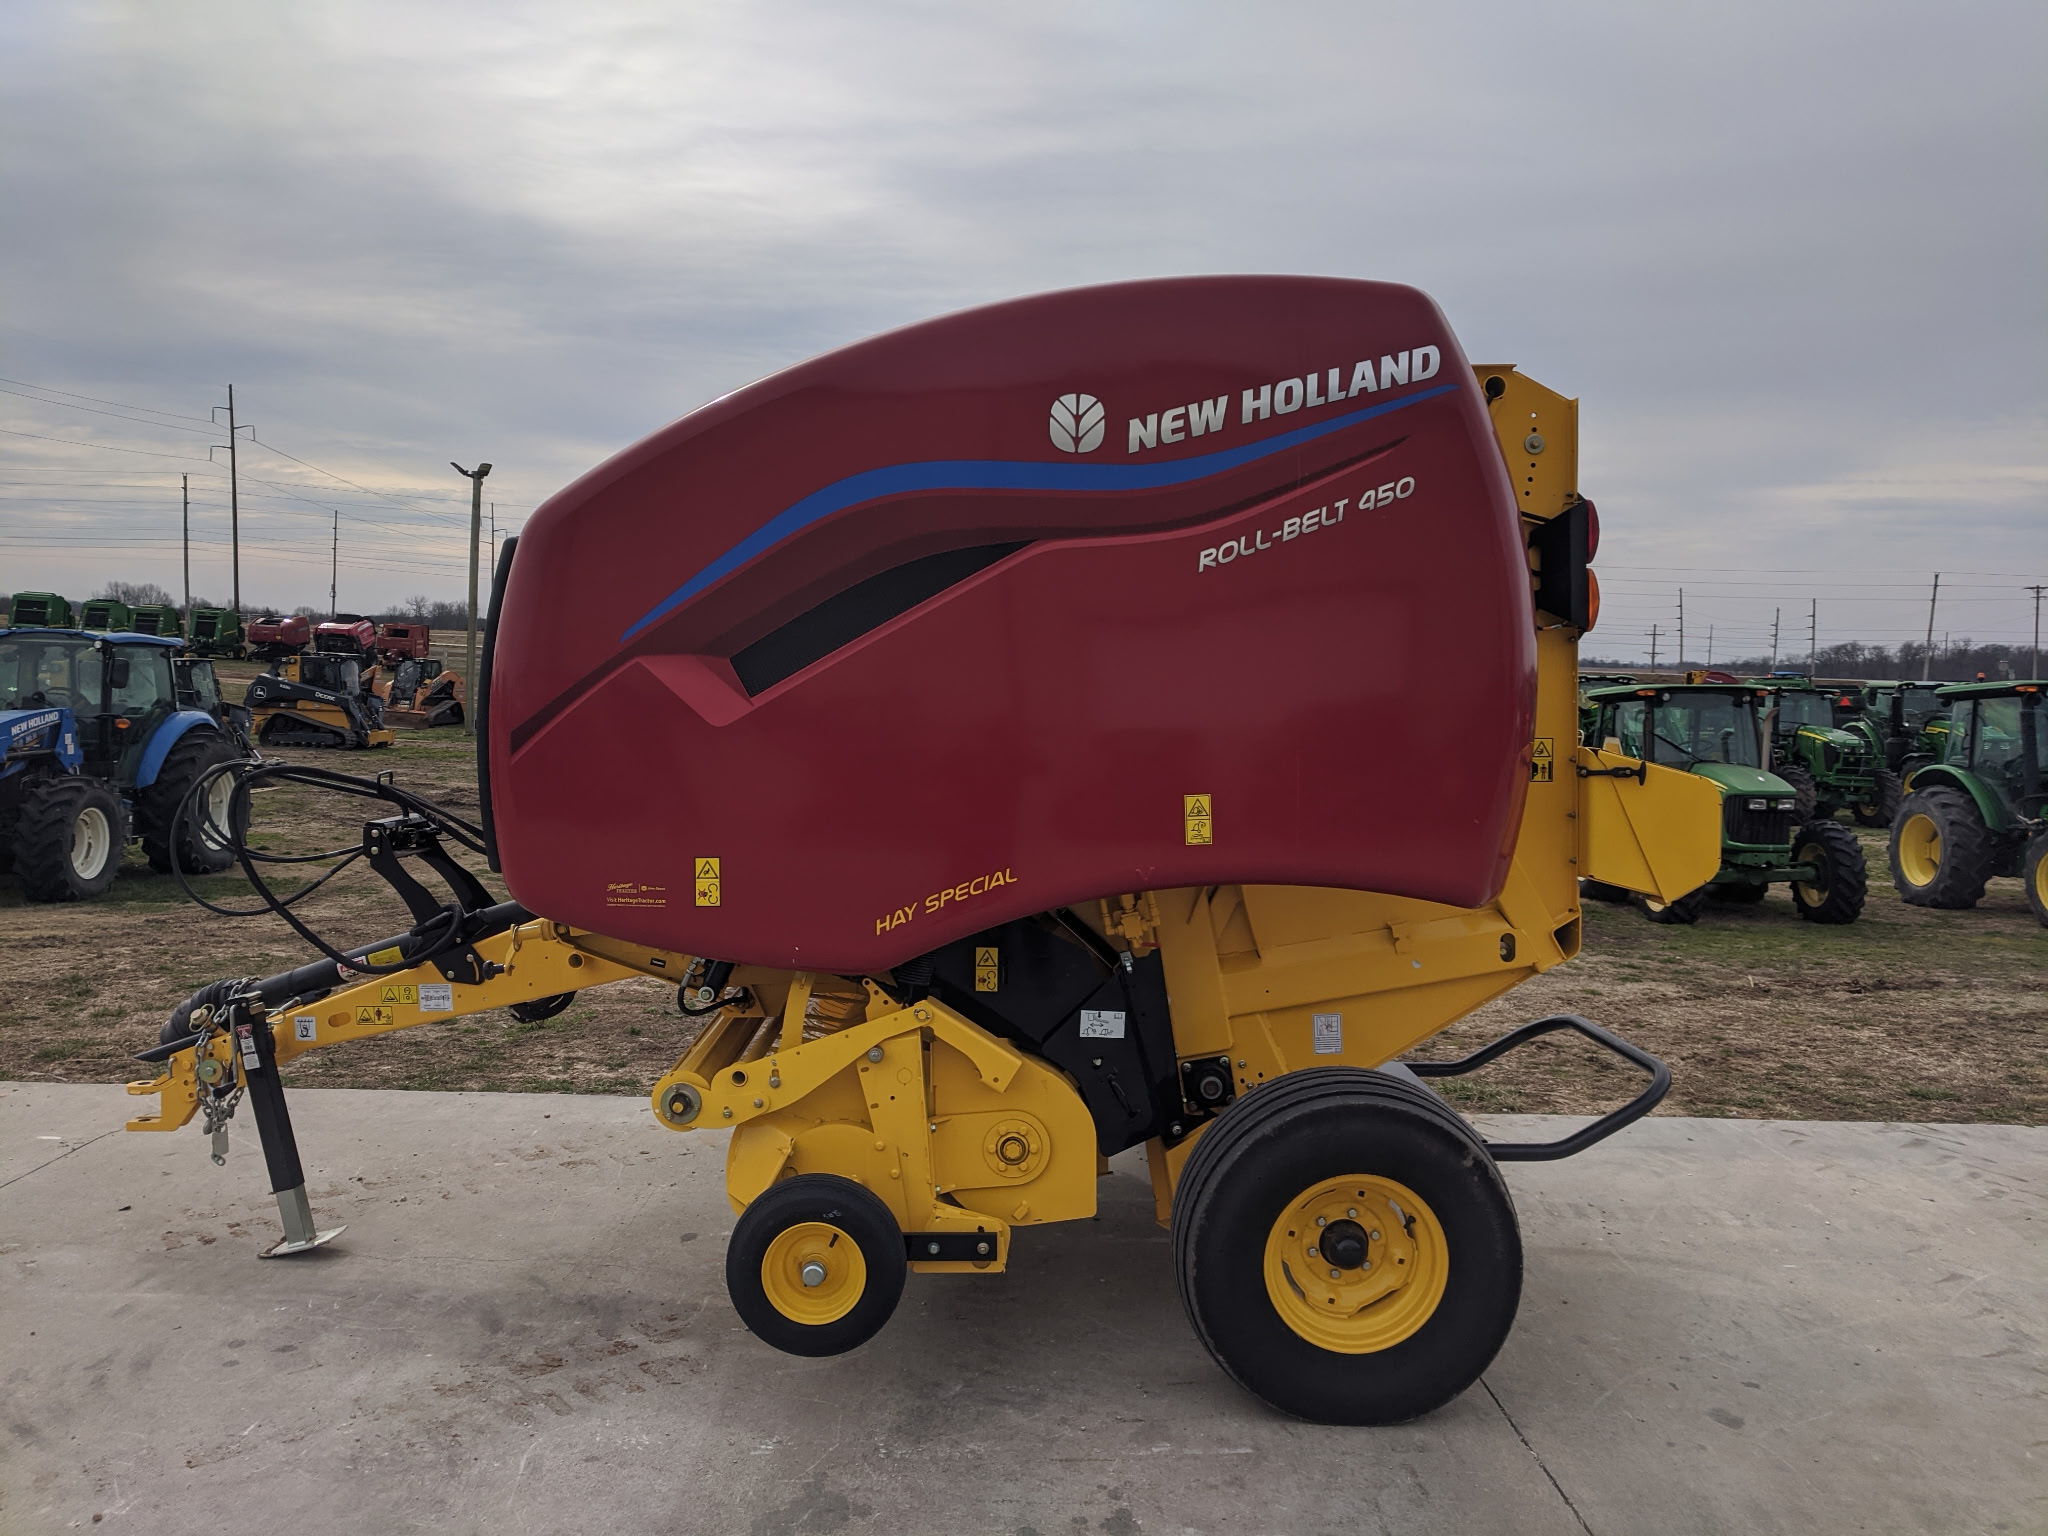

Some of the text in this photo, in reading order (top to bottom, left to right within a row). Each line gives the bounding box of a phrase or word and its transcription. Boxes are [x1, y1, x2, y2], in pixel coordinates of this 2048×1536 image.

[1128, 344, 1441, 454] NEW HOLLAND
[1198, 476, 1416, 573] ROLL-BELT 450
[11, 711, 58, 736] NEW HOLLAND
[876, 867, 1018, 936] HAY SPECIAL
